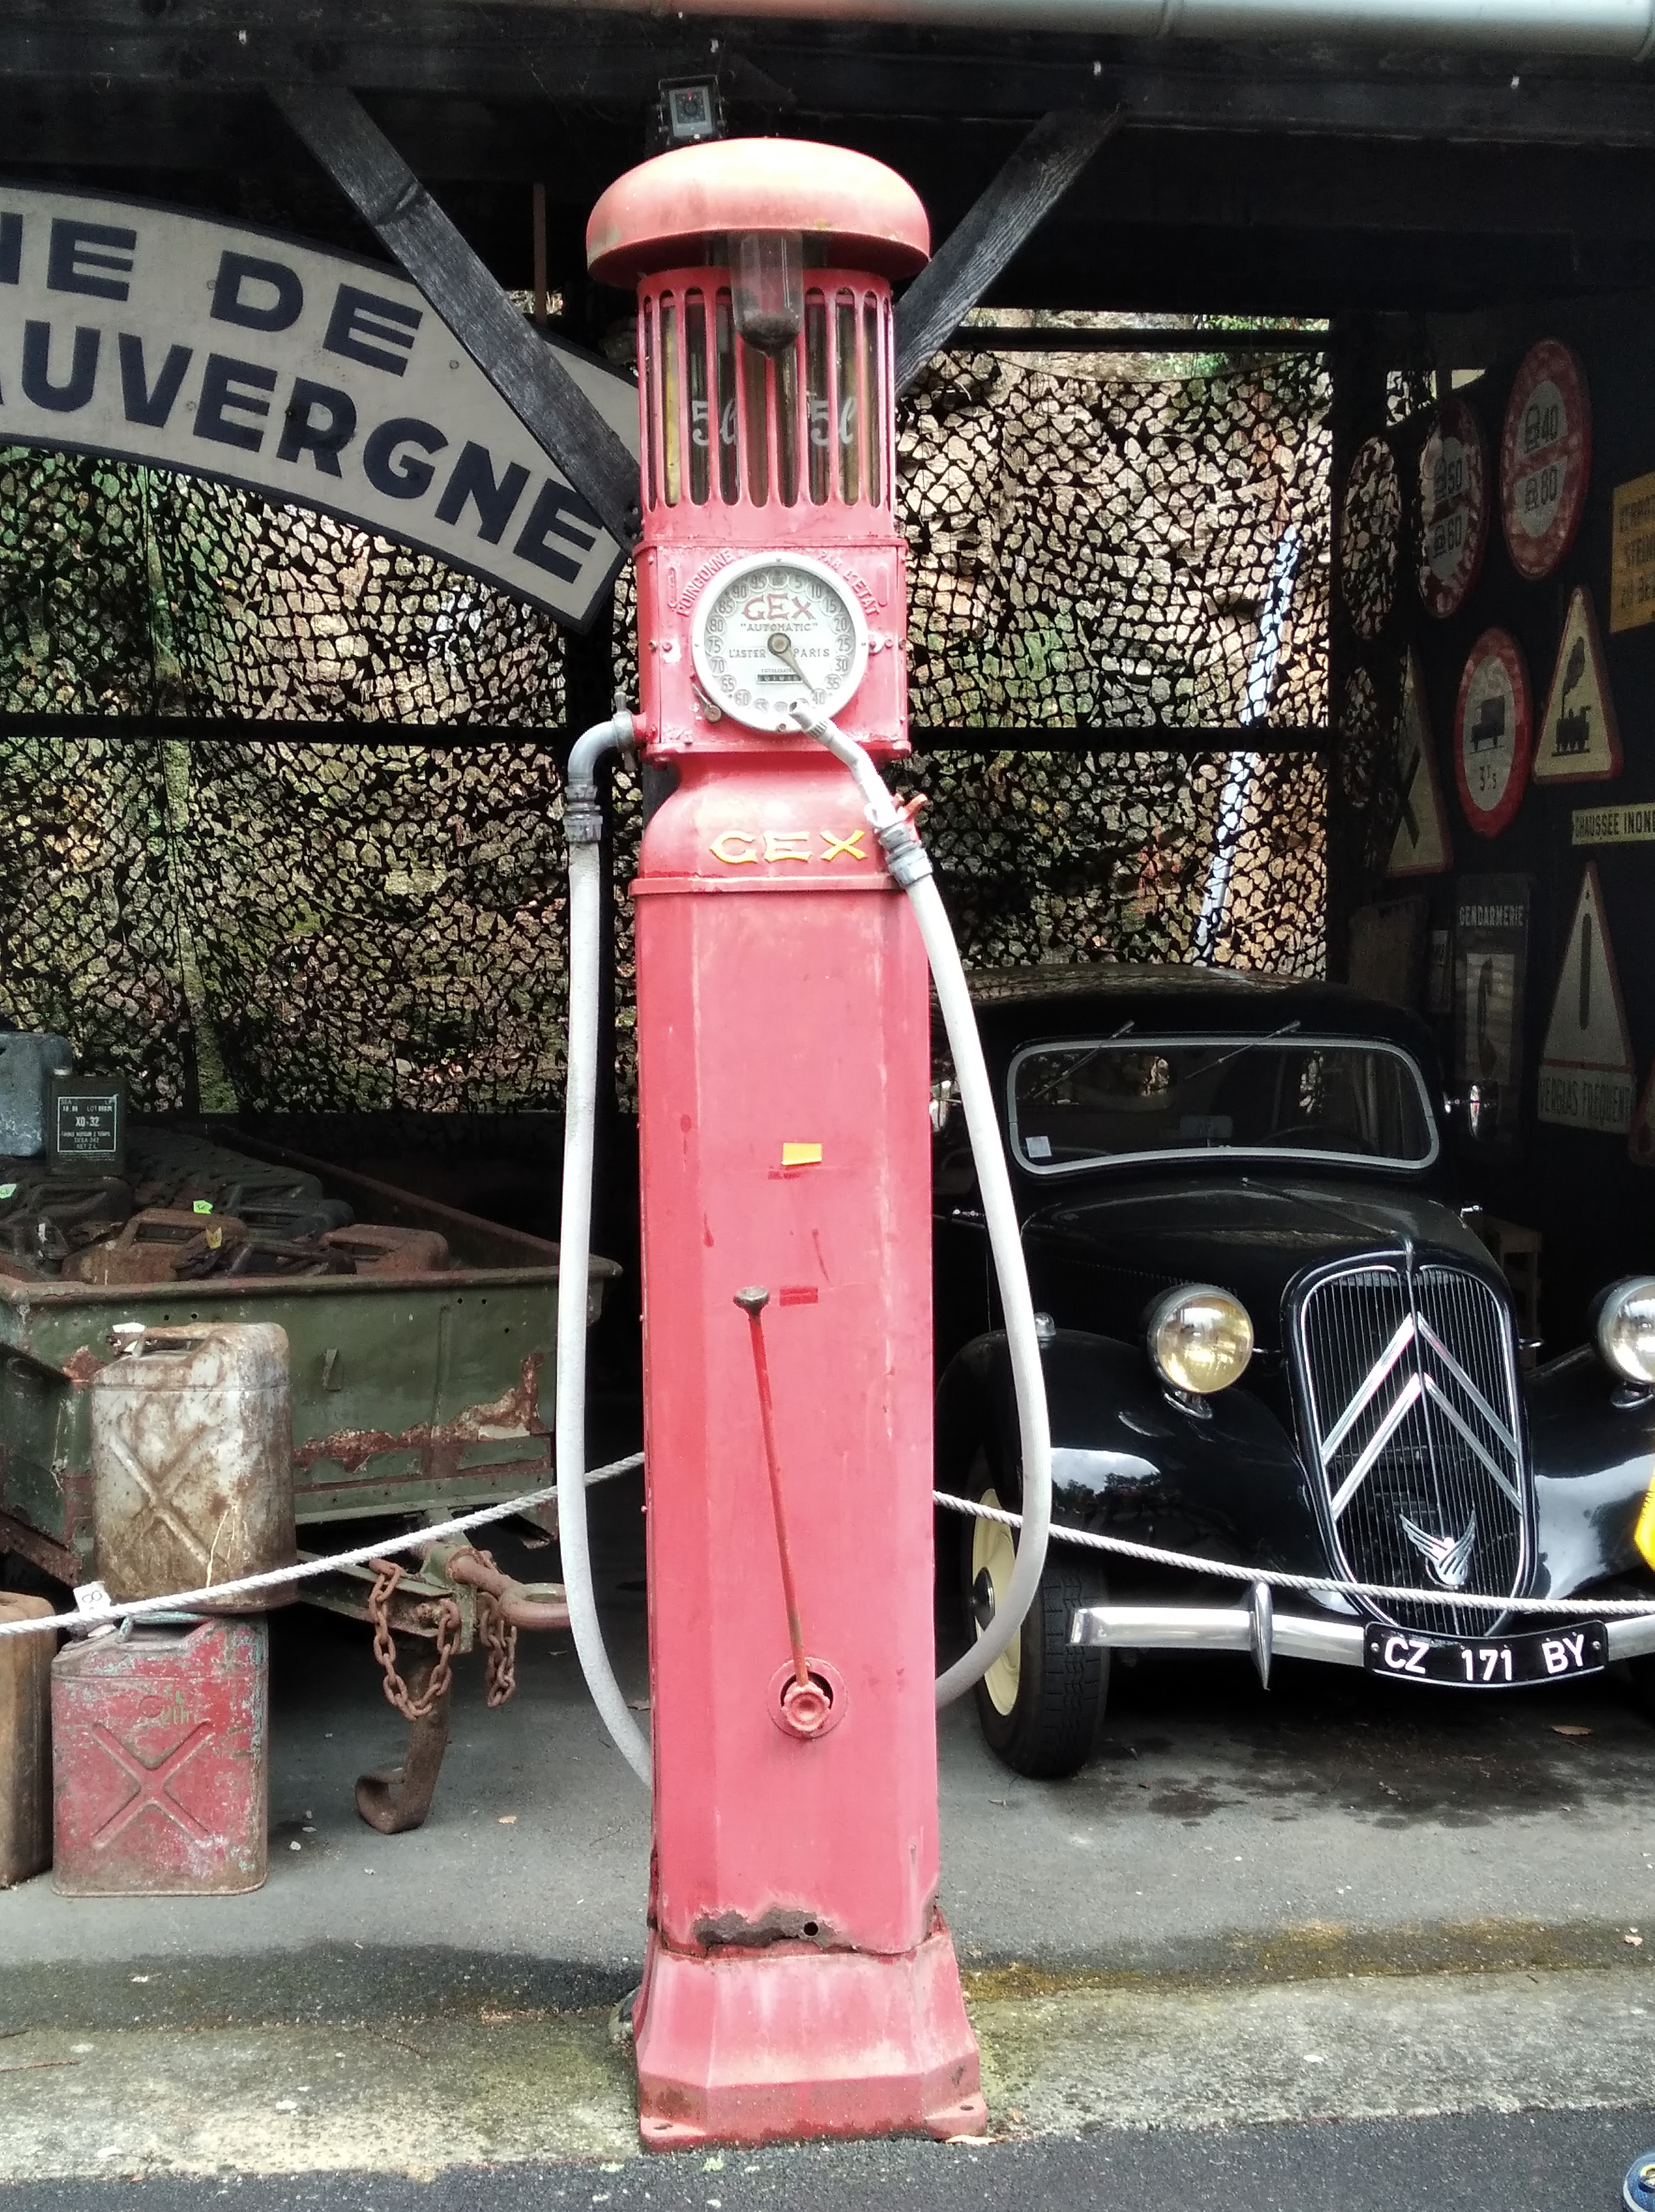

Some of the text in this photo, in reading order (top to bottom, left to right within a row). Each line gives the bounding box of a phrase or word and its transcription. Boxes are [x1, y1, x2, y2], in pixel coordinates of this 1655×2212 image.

[211, 250, 423, 377] DE
[0, 320, 603, 584] UVERGNE
[733, 585, 747, 599] 90
[812, 584, 821, 599] 10
[742, 593, 816, 621] GEX
[826, 599, 837, 613] 15
[710, 618, 723, 633] 80
[834, 617, 847, 632] 20
[708, 639, 721, 654] 75
[837, 637, 851, 652] 25
[793, 648, 830, 658] PARIS
[711, 658, 725, 674] 70
[835, 658, 848, 672] 30
[826, 676, 840, 690] 35
[812, 691, 825, 706] 40
[1624, 809, 1655, 834] INON
[710, 830, 867, 864] GEX
[1459, 905, 1524, 927] GENDARMERIE
[1384, 1634, 1585, 1680] CZ 171 BY
